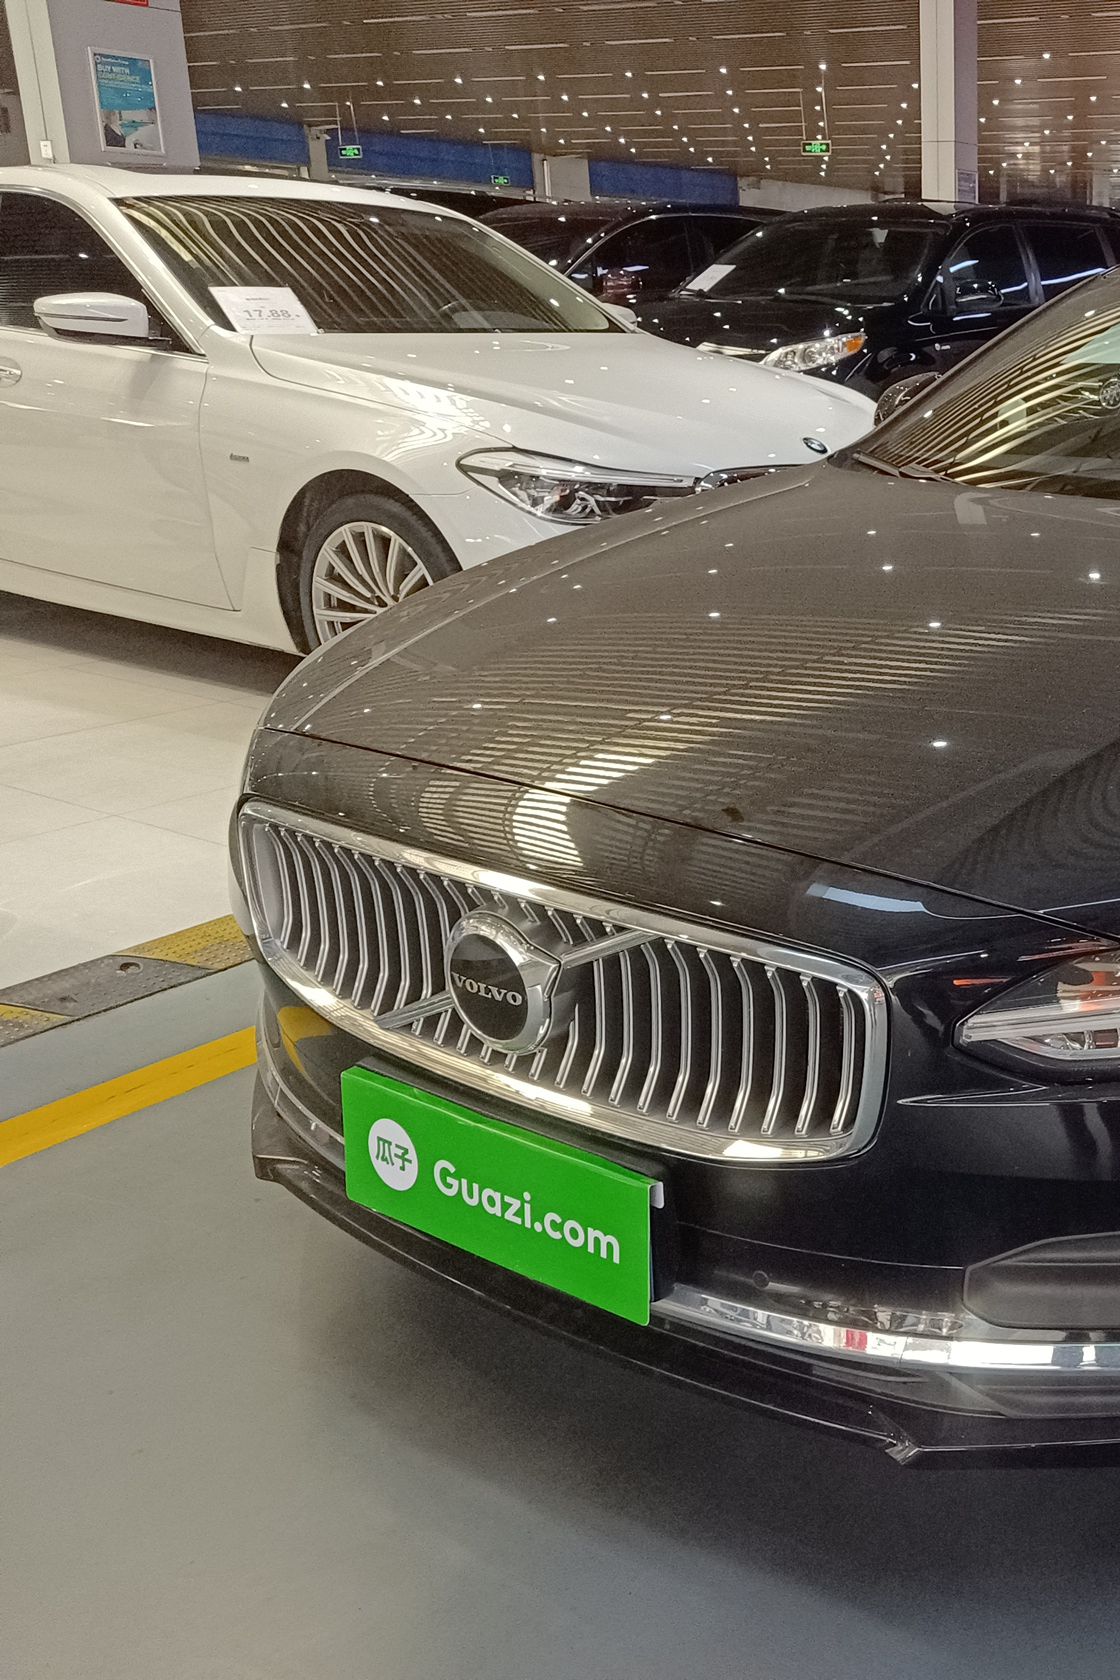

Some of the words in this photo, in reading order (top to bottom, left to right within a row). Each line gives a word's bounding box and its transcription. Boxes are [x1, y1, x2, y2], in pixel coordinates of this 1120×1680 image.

[243, 309, 291, 318] 17.88
[451, 972, 522, 1005] VOLVO
[375, 1135, 413, 1172] 瓜子
[433, 1159, 620, 1265] Guazi.com
